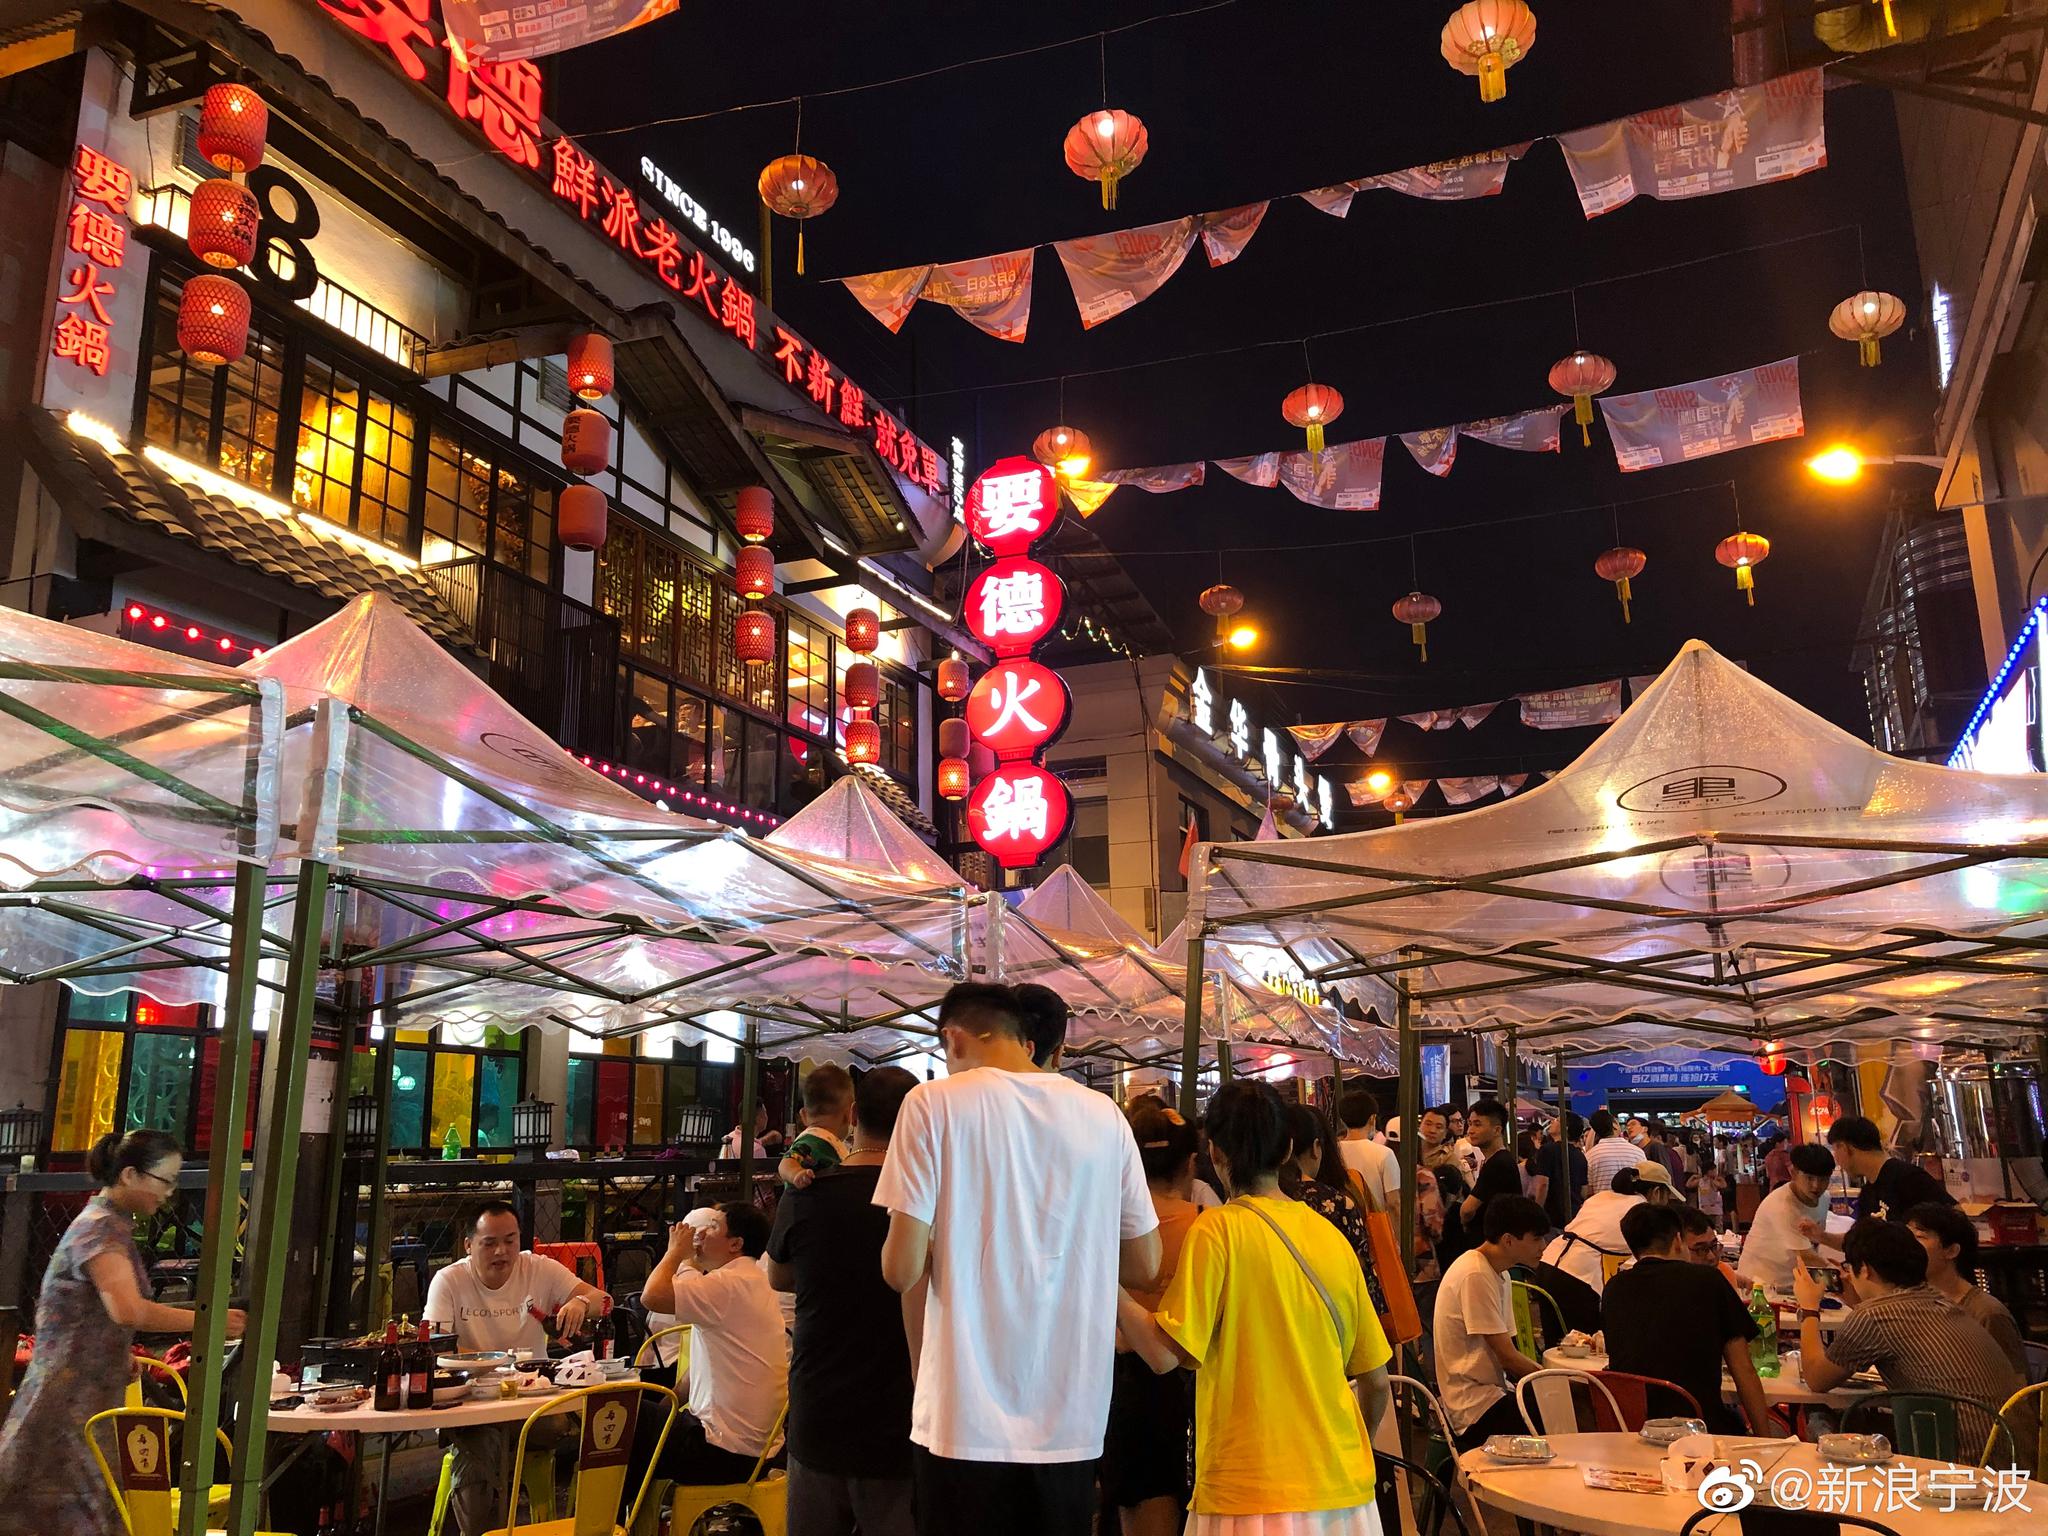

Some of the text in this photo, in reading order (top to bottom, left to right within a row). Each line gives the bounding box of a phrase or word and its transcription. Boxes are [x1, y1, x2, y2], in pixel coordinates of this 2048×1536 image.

[55, 143, 133, 377] 要德火鍋
[552, 135, 757, 350] 鮮派老火鍋
[640, 155, 756, 274] SINCE 1996
[979, 469, 1048, 841] 要德火鍋
